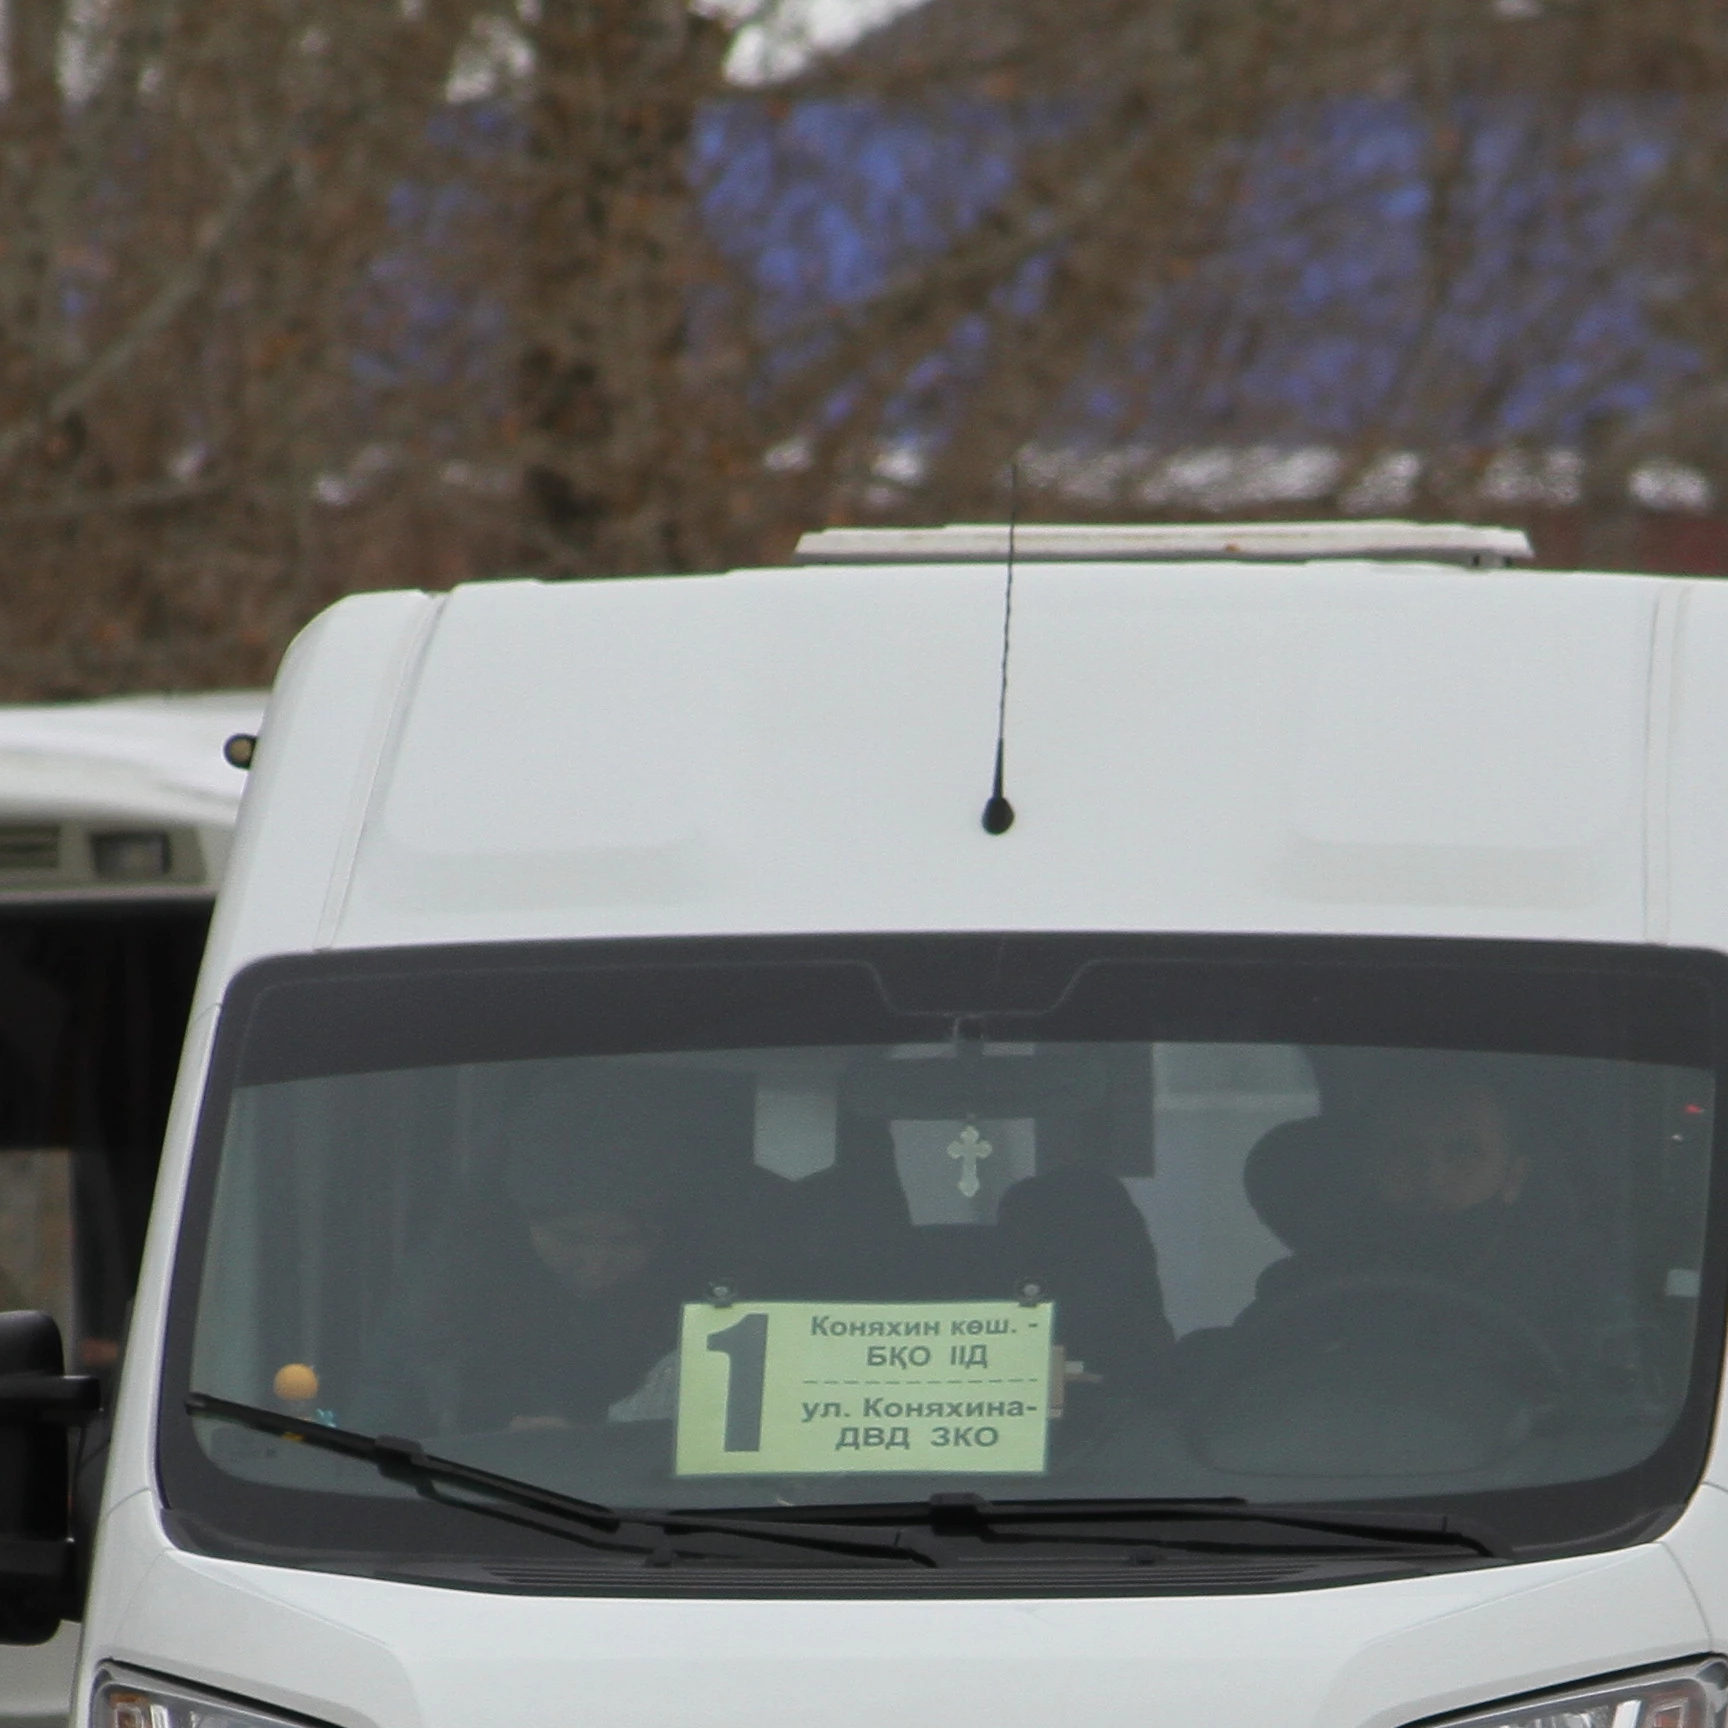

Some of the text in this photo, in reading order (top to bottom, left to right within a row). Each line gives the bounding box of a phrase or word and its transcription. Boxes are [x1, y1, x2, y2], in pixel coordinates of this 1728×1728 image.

[810, 1315, 940, 1337] Коняхин
[949, 1317, 1017, 1335] көш.
[866, 1345, 931, 1369] БҚО
[706, 1313, 770, 1452] 1
[801, 1397, 1038, 1422] ул. Коняхина-
[835, 1426, 1000, 1450] ДВД ЗКО
